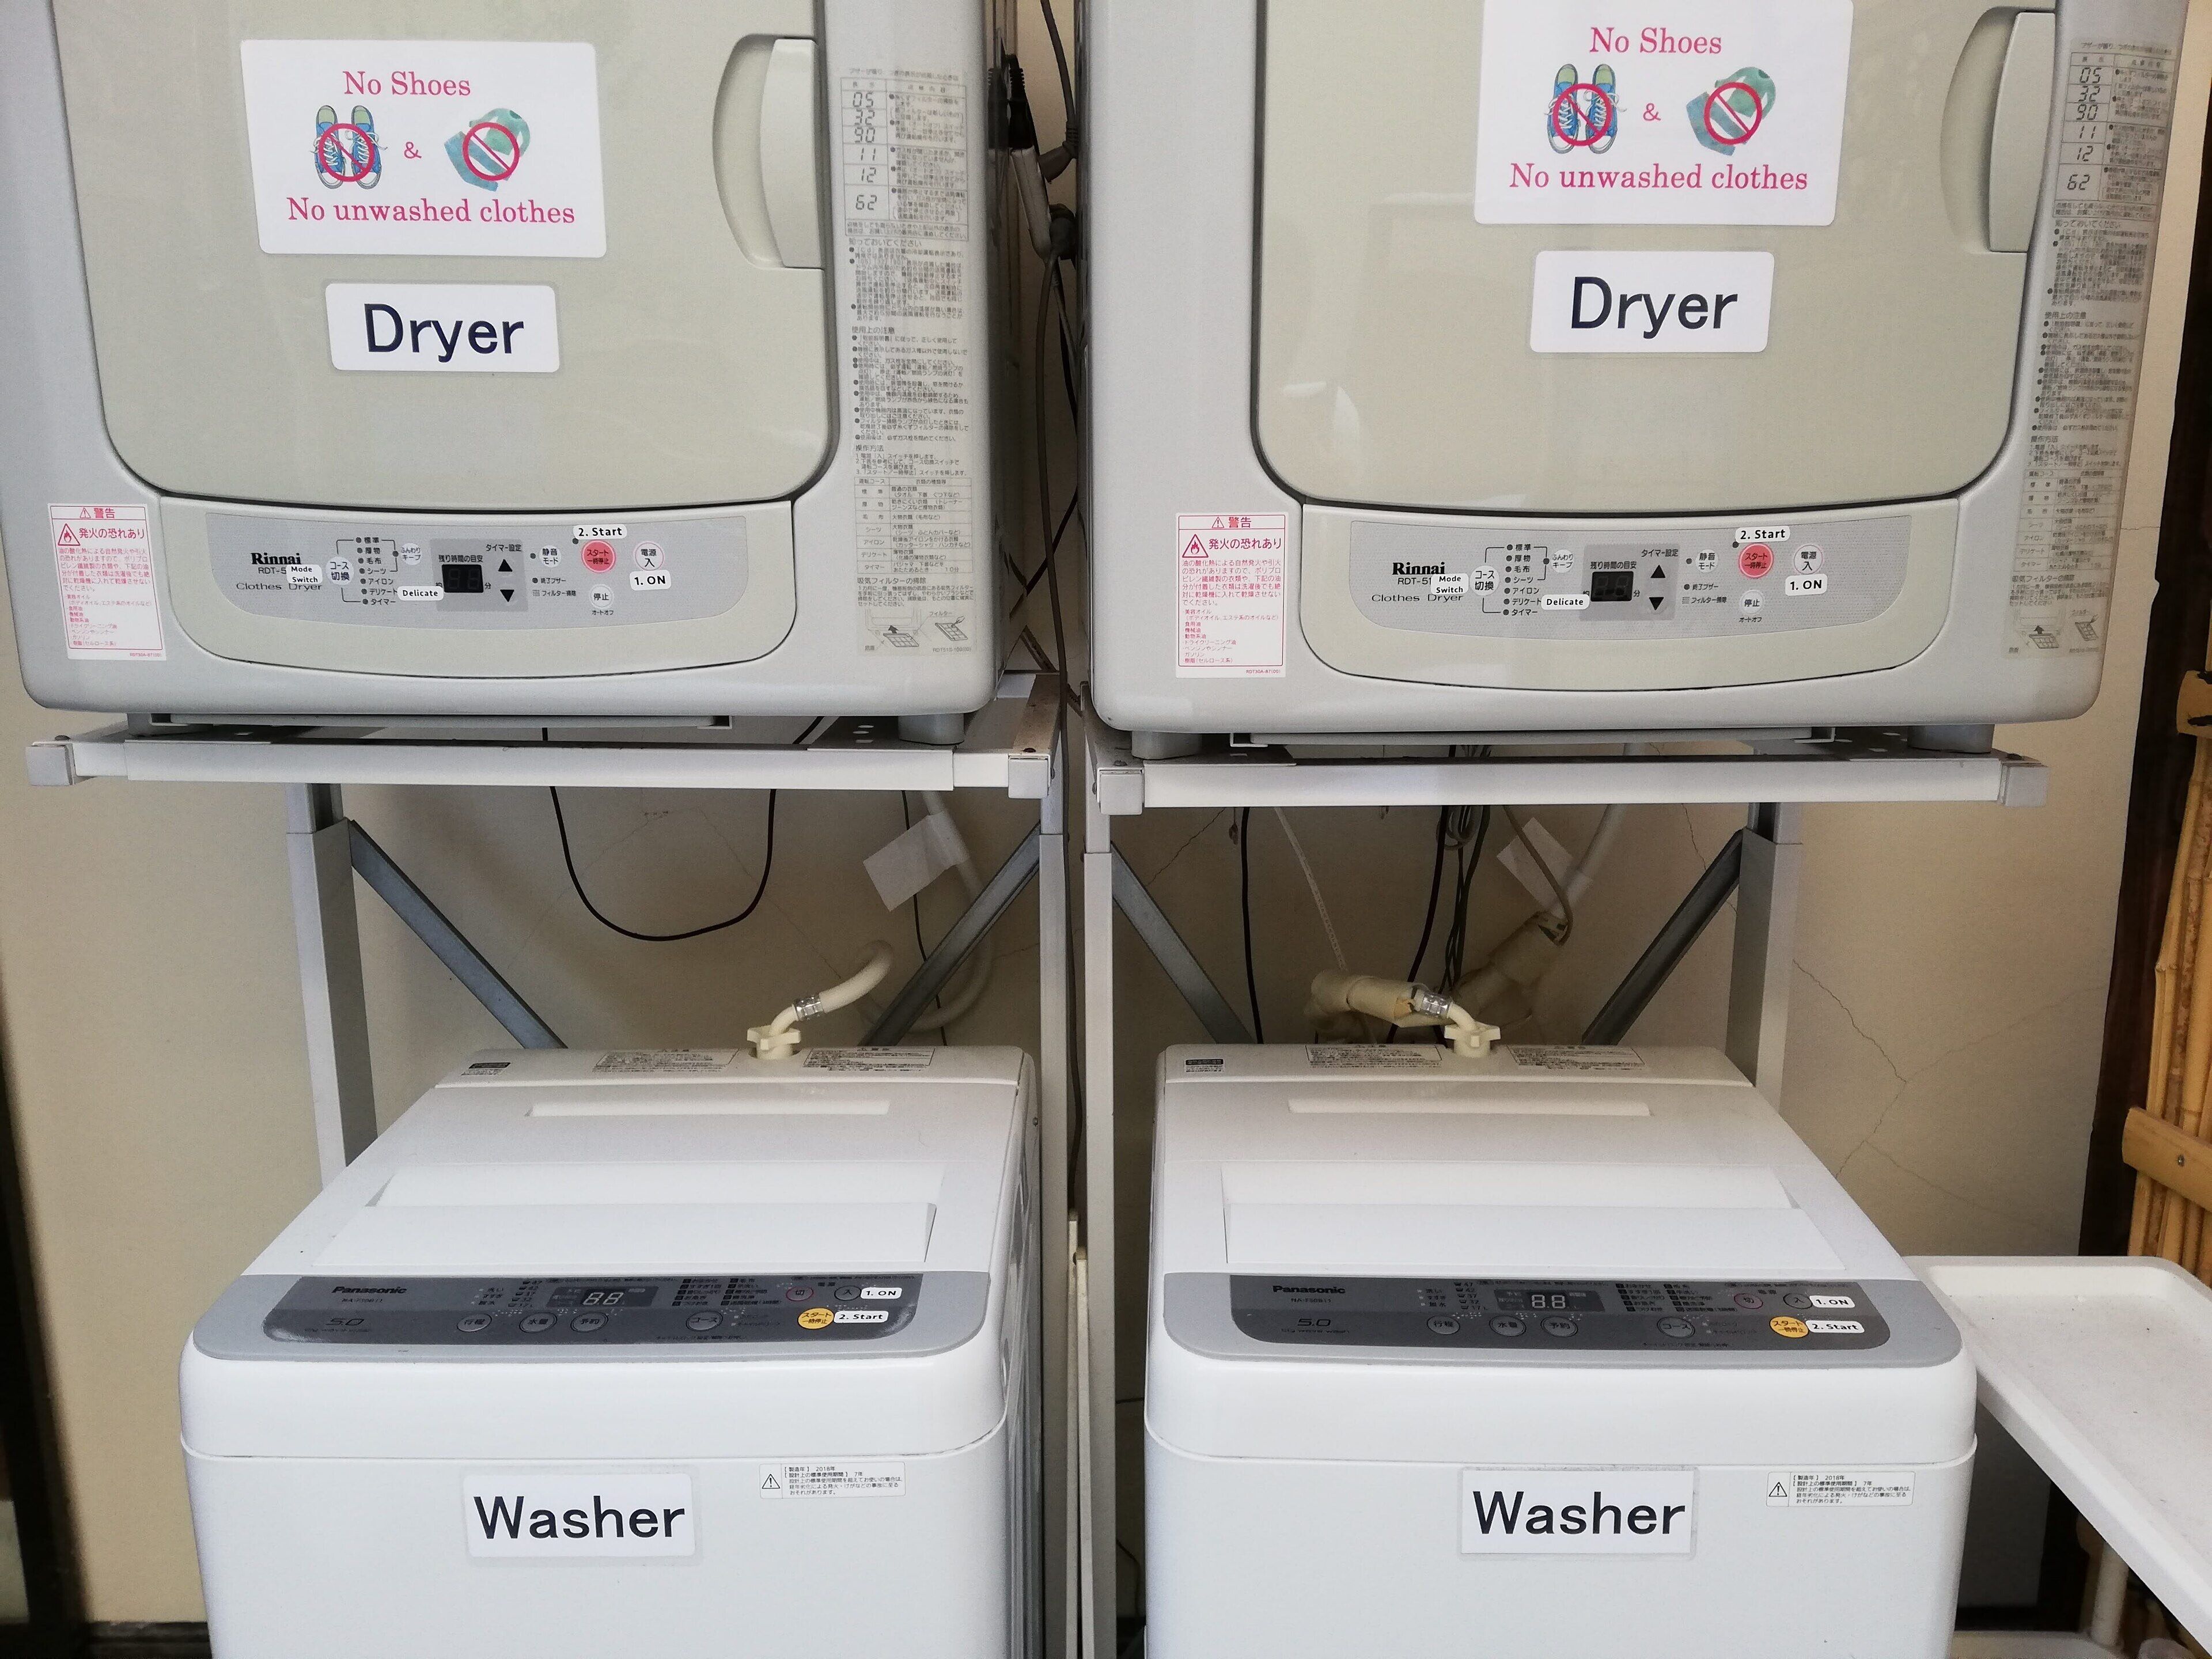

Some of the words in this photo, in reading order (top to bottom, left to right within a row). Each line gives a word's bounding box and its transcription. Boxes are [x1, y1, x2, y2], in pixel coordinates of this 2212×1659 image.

[1590, 27, 1629, 53] No
[1640, 28, 1722, 54] Shoes
[343, 71, 381, 95] No
[392, 71, 471, 96] Shoes
[1643, 104, 1661, 121] &
[404, 142, 422, 159] &
[1509, 164, 1549, 188] No
[1560, 164, 1702, 189] unwashed
[1712, 164, 1808, 190] clothes
[2067, 174, 2090, 190] 62
[855, 194, 877, 211] 62
[287, 198, 325, 221] No
[334, 199, 471, 223] unwashed
[480, 199, 575, 224] clothes
[1571, 276, 1737, 339] Dryer
[364, 303, 524, 362] Dryer
[94, 507, 115, 518] 警告
[1229, 517, 1251, 528] 警告
[79, 528, 144, 539] 発火の恐れあり
[578, 528, 588, 536] 2.
[593, 527, 622, 536] Start
[1741, 531, 1750, 539] 2.
[1755, 529, 1785, 539] Start
[1209, 538, 1282, 550] 発火の恐れあり
[251, 553, 301, 565] Rinnai
[1699, 552, 1715, 560] 静音
[330, 562, 349, 570] コース
[645, 558, 654, 567] 入
[1802, 562, 1813, 571] 入
[1392, 562, 1445, 575] Rinnai
[331, 572, 350, 581] 切換
[634, 577, 643, 585] 1.
[647, 576, 666, 585] ON
[1475, 581, 1494, 590] 切換
[1790, 581, 1798, 590] 1.
[1803, 580, 1822, 589] ON
[593, 593, 609, 601] 停止
[1273, 1286, 1345, 1294] Panasonic
[474, 1495, 685, 1539] Washer
[1473, 1490, 1685, 1535] Washer
